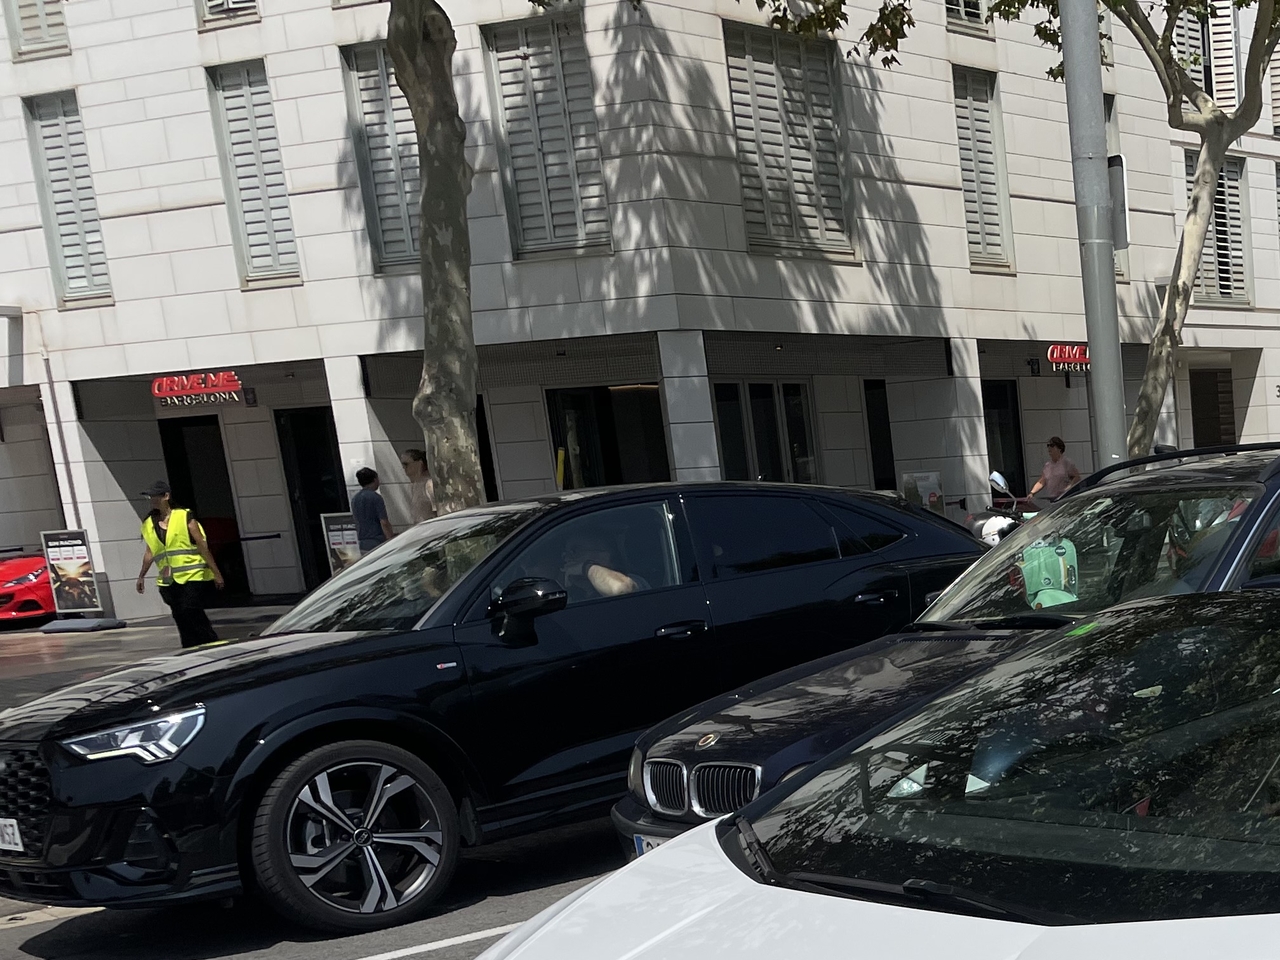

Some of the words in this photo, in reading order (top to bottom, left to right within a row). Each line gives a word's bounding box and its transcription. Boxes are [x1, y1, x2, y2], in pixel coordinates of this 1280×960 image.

[151, 373, 205, 396] DRIVE
[206, 371, 240, 389] ME
[161, 391, 239, 406] BARCELONA
